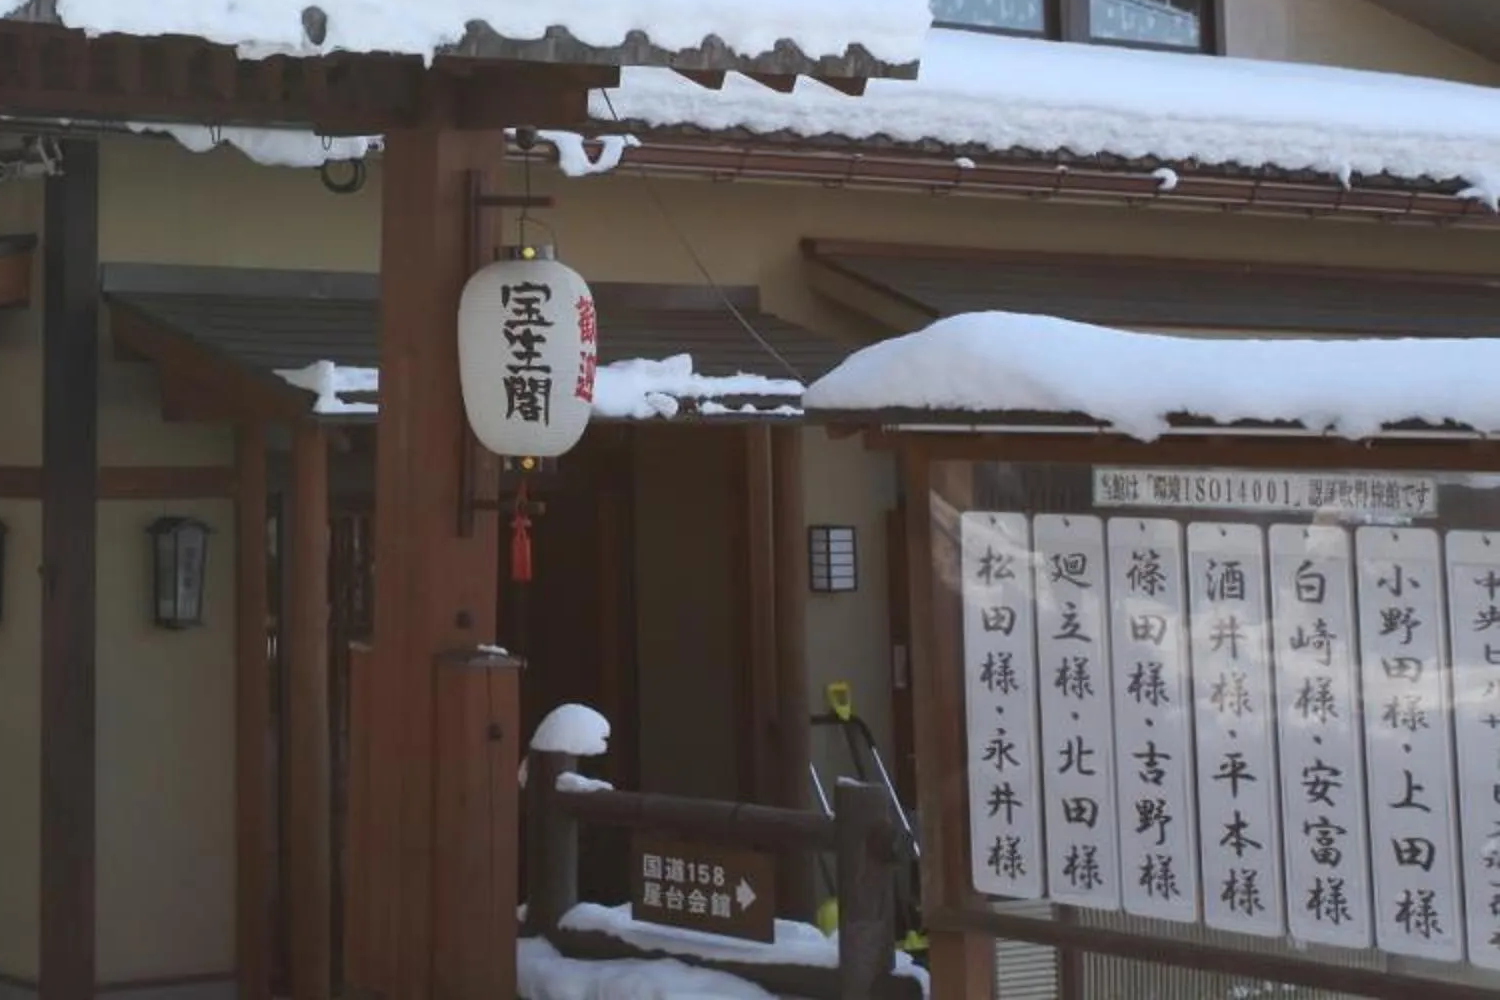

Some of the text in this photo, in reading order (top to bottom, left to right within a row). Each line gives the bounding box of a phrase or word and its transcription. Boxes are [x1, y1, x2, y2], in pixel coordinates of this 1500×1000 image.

[501, 281, 554, 427] 宝生閣
[1205, 558, 1266, 916] 酒井様・平本様
[1376, 564, 1444, 940] 小野田様・上田様
